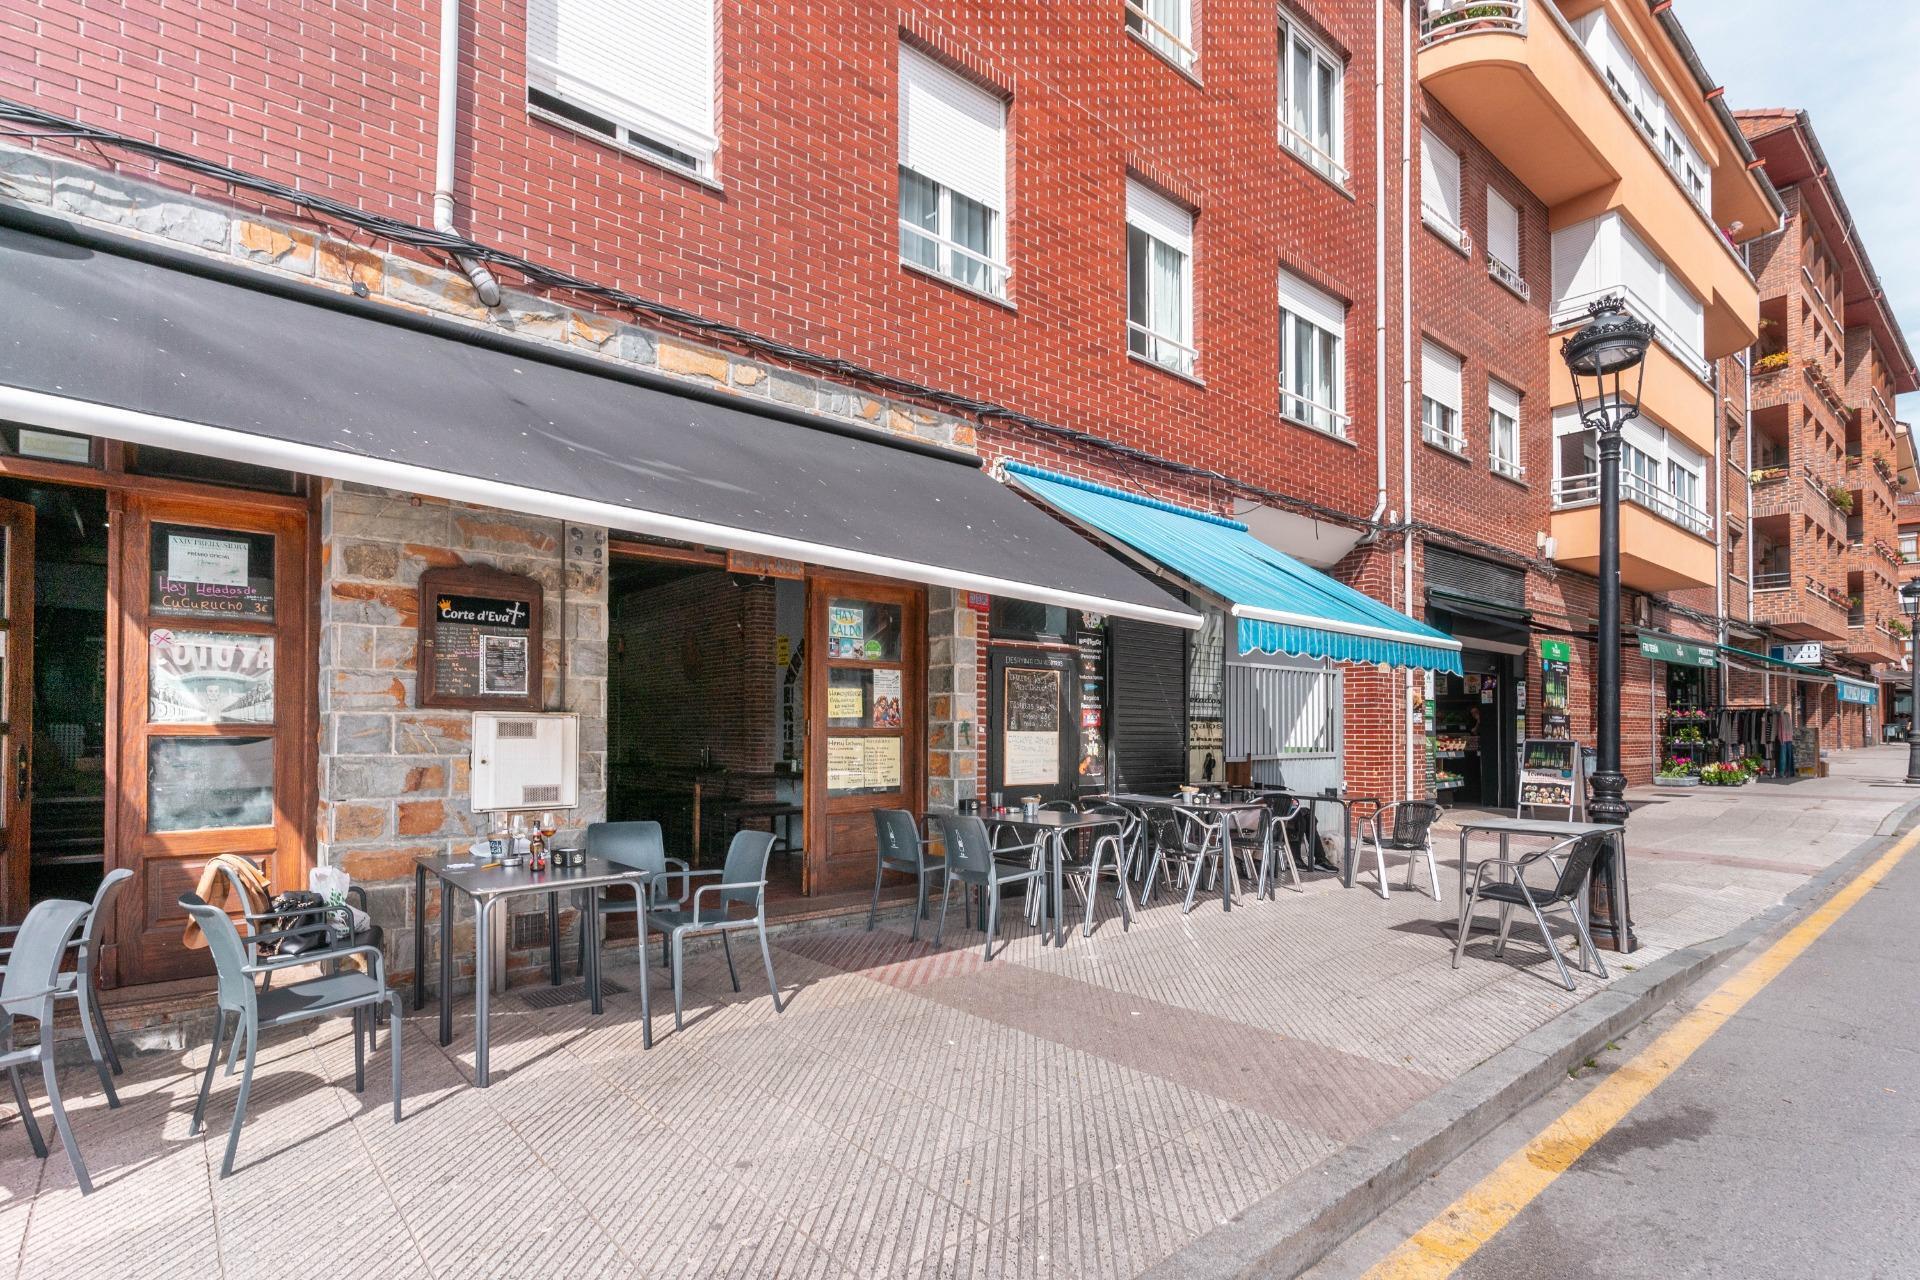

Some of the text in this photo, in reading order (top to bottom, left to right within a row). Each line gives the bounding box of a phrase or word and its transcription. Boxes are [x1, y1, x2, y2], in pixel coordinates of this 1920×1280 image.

[442, 607, 510, 624] Corte d'Eva
[835, 609, 860, 621] HAY
[832, 624, 862, 637] CALDO
